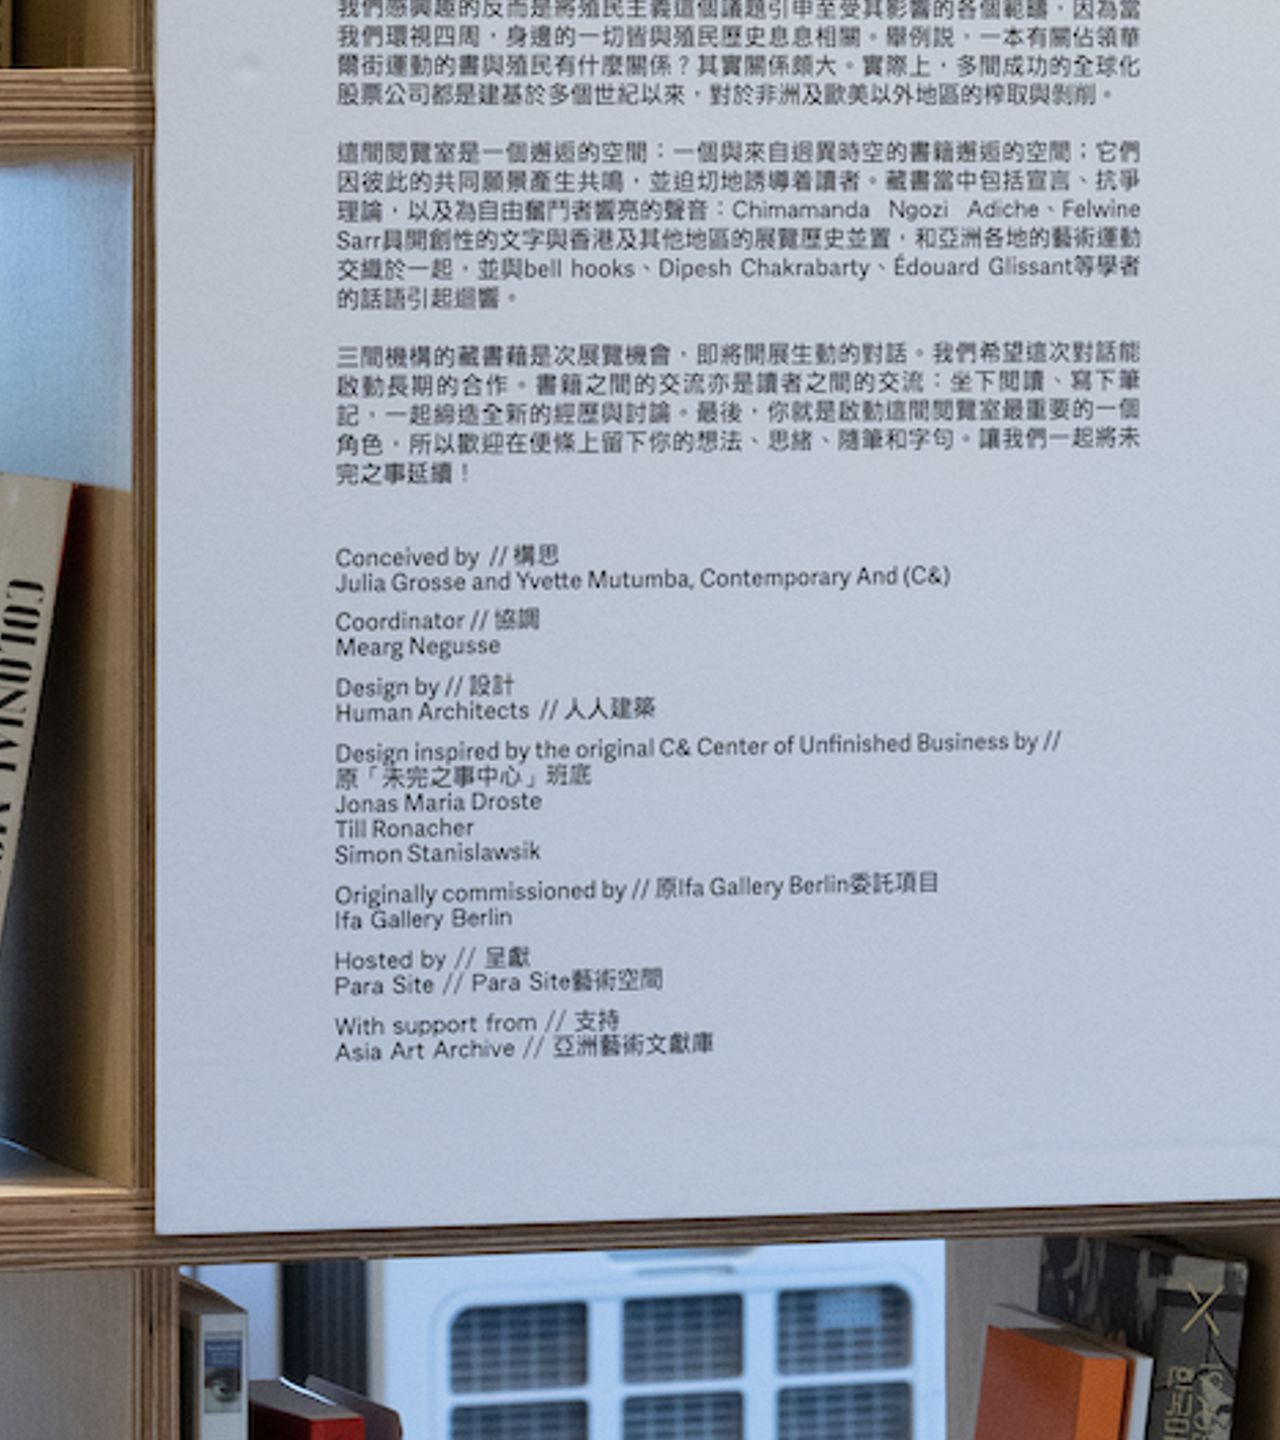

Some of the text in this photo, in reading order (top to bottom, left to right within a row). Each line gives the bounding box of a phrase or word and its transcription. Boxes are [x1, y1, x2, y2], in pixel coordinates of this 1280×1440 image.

[335, 545, 450, 569] Conceived
[454, 545, 480, 572] by
[488, 545, 509, 568] //
[335, 634, 501, 662] Mearg Negusse
[335, 702, 413, 723] Human
[417, 695, 531, 722] Architects
[538, 698, 560, 721] //
[334, 1042, 383, 1063] Asia
[389, 1034, 425, 1061] Art
[432, 1034, 516, 1060] Archive
[522, 1035, 545, 1059] //
